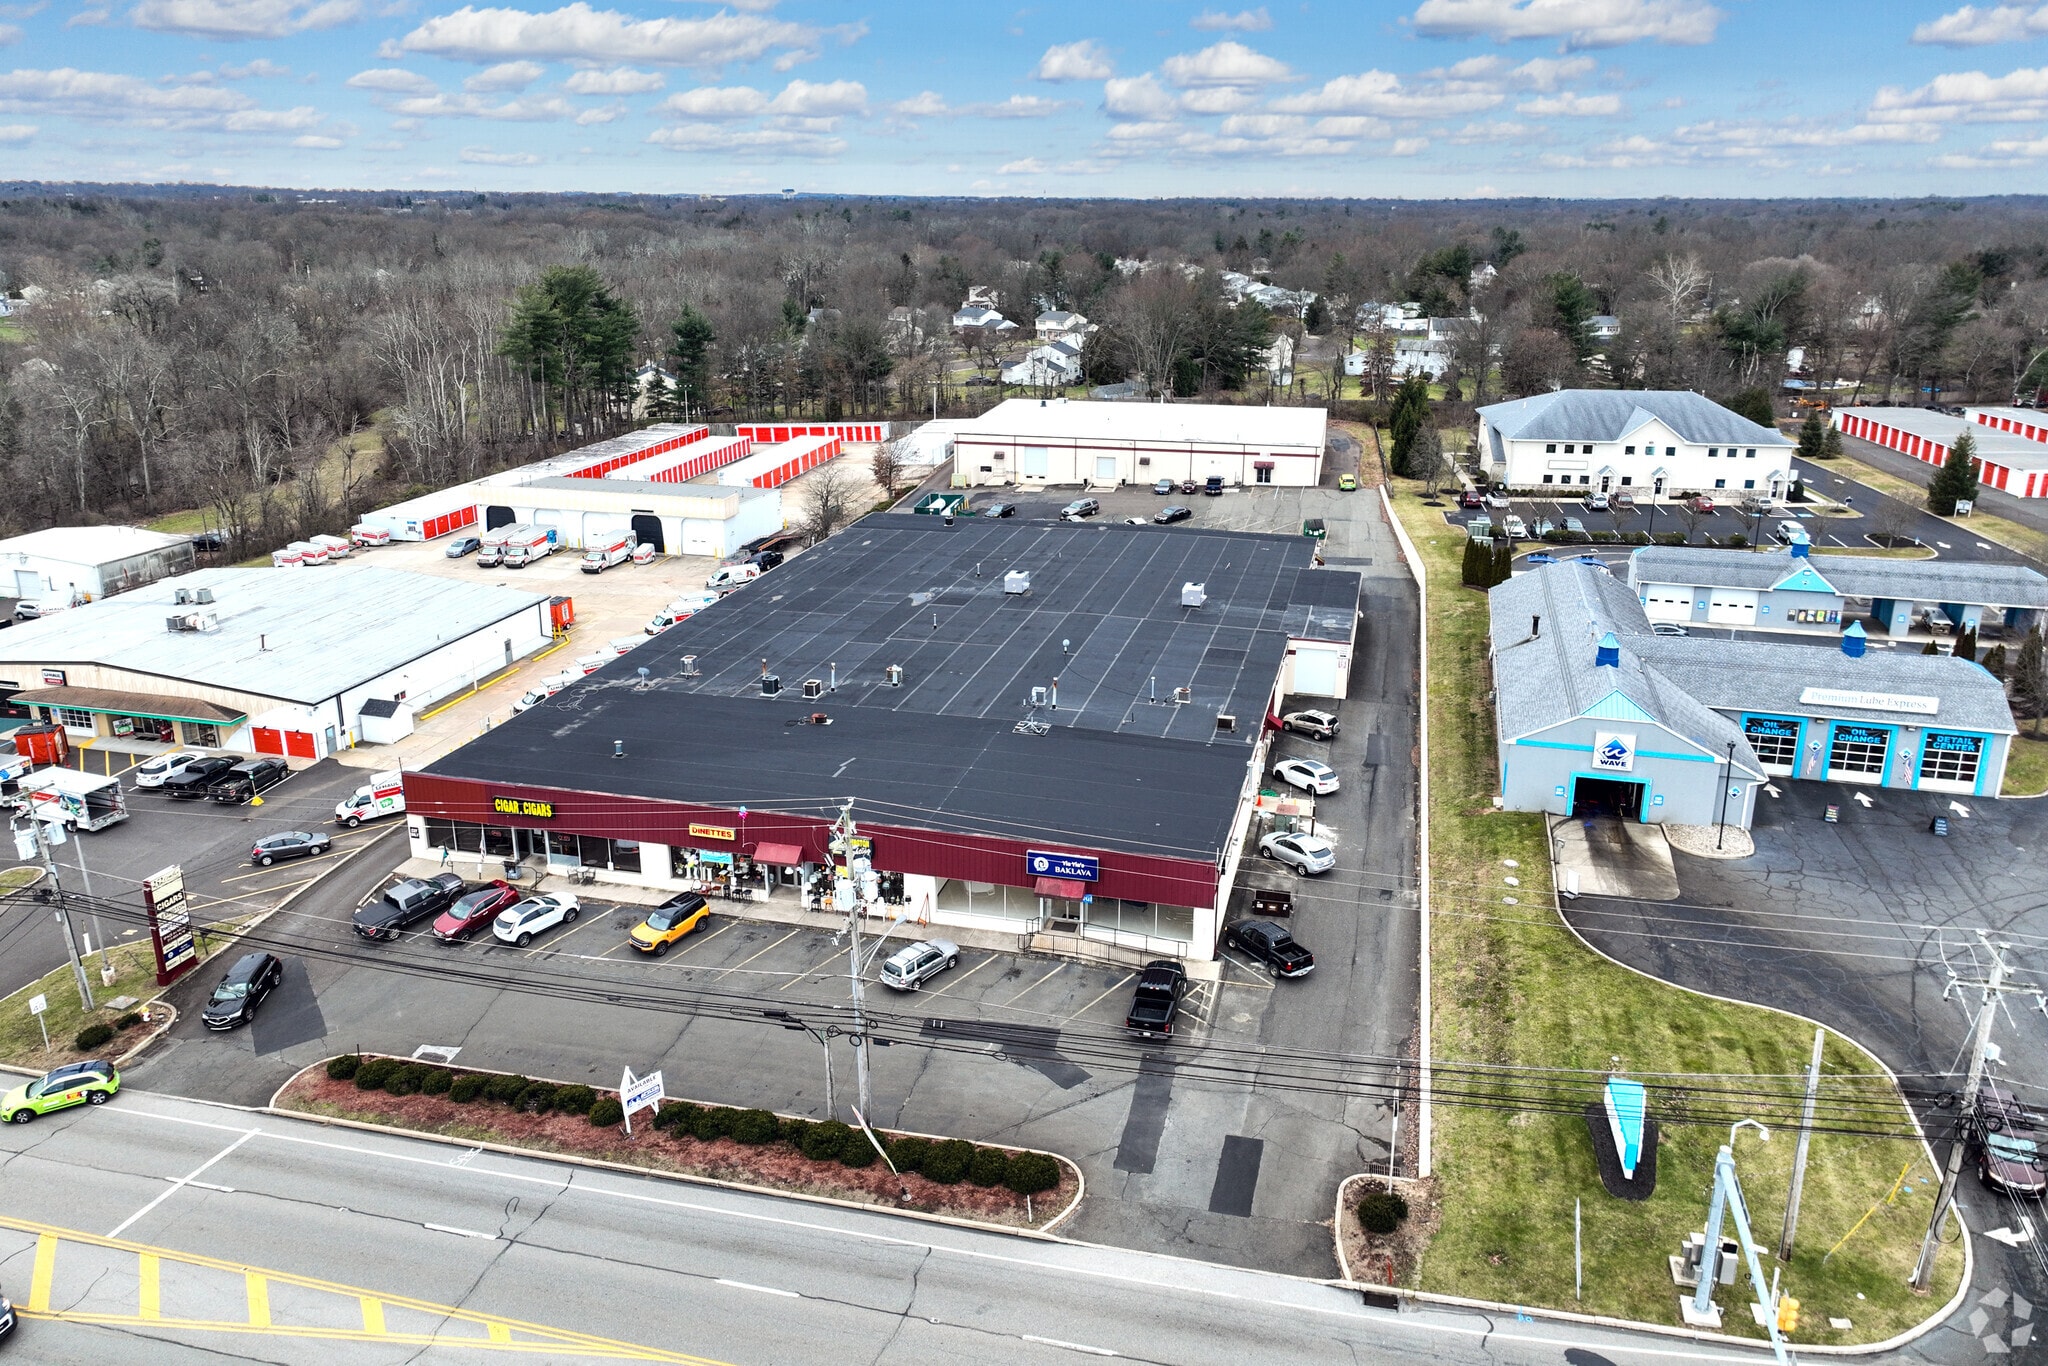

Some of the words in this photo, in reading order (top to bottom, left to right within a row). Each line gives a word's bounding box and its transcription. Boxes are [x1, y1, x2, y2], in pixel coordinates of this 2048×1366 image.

[1811, 691, 1857, 704] Premium
[1860, 695, 1885, 706] Lube
[1887, 698, 1927, 709] Express
[1763, 720, 1780, 729] OIL
[1750, 726, 1793, 736] CHANGE
[1851, 728, 1868, 736] OIL
[1838, 733, 1881, 744] CHANGE
[1936, 735, 1974, 745] DETAIL
[1932, 742, 1976, 752] CENTER
[1600, 759, 1627, 767] WAVE
[523, 801, 553, 818] CIGARS
[692, 827, 732, 838] DINETTES
[1055, 866, 1092, 876] BAKLAVA
[156, 892, 184, 911] CIGARS
[628, 1075, 657, 1093] AVAILABLE
